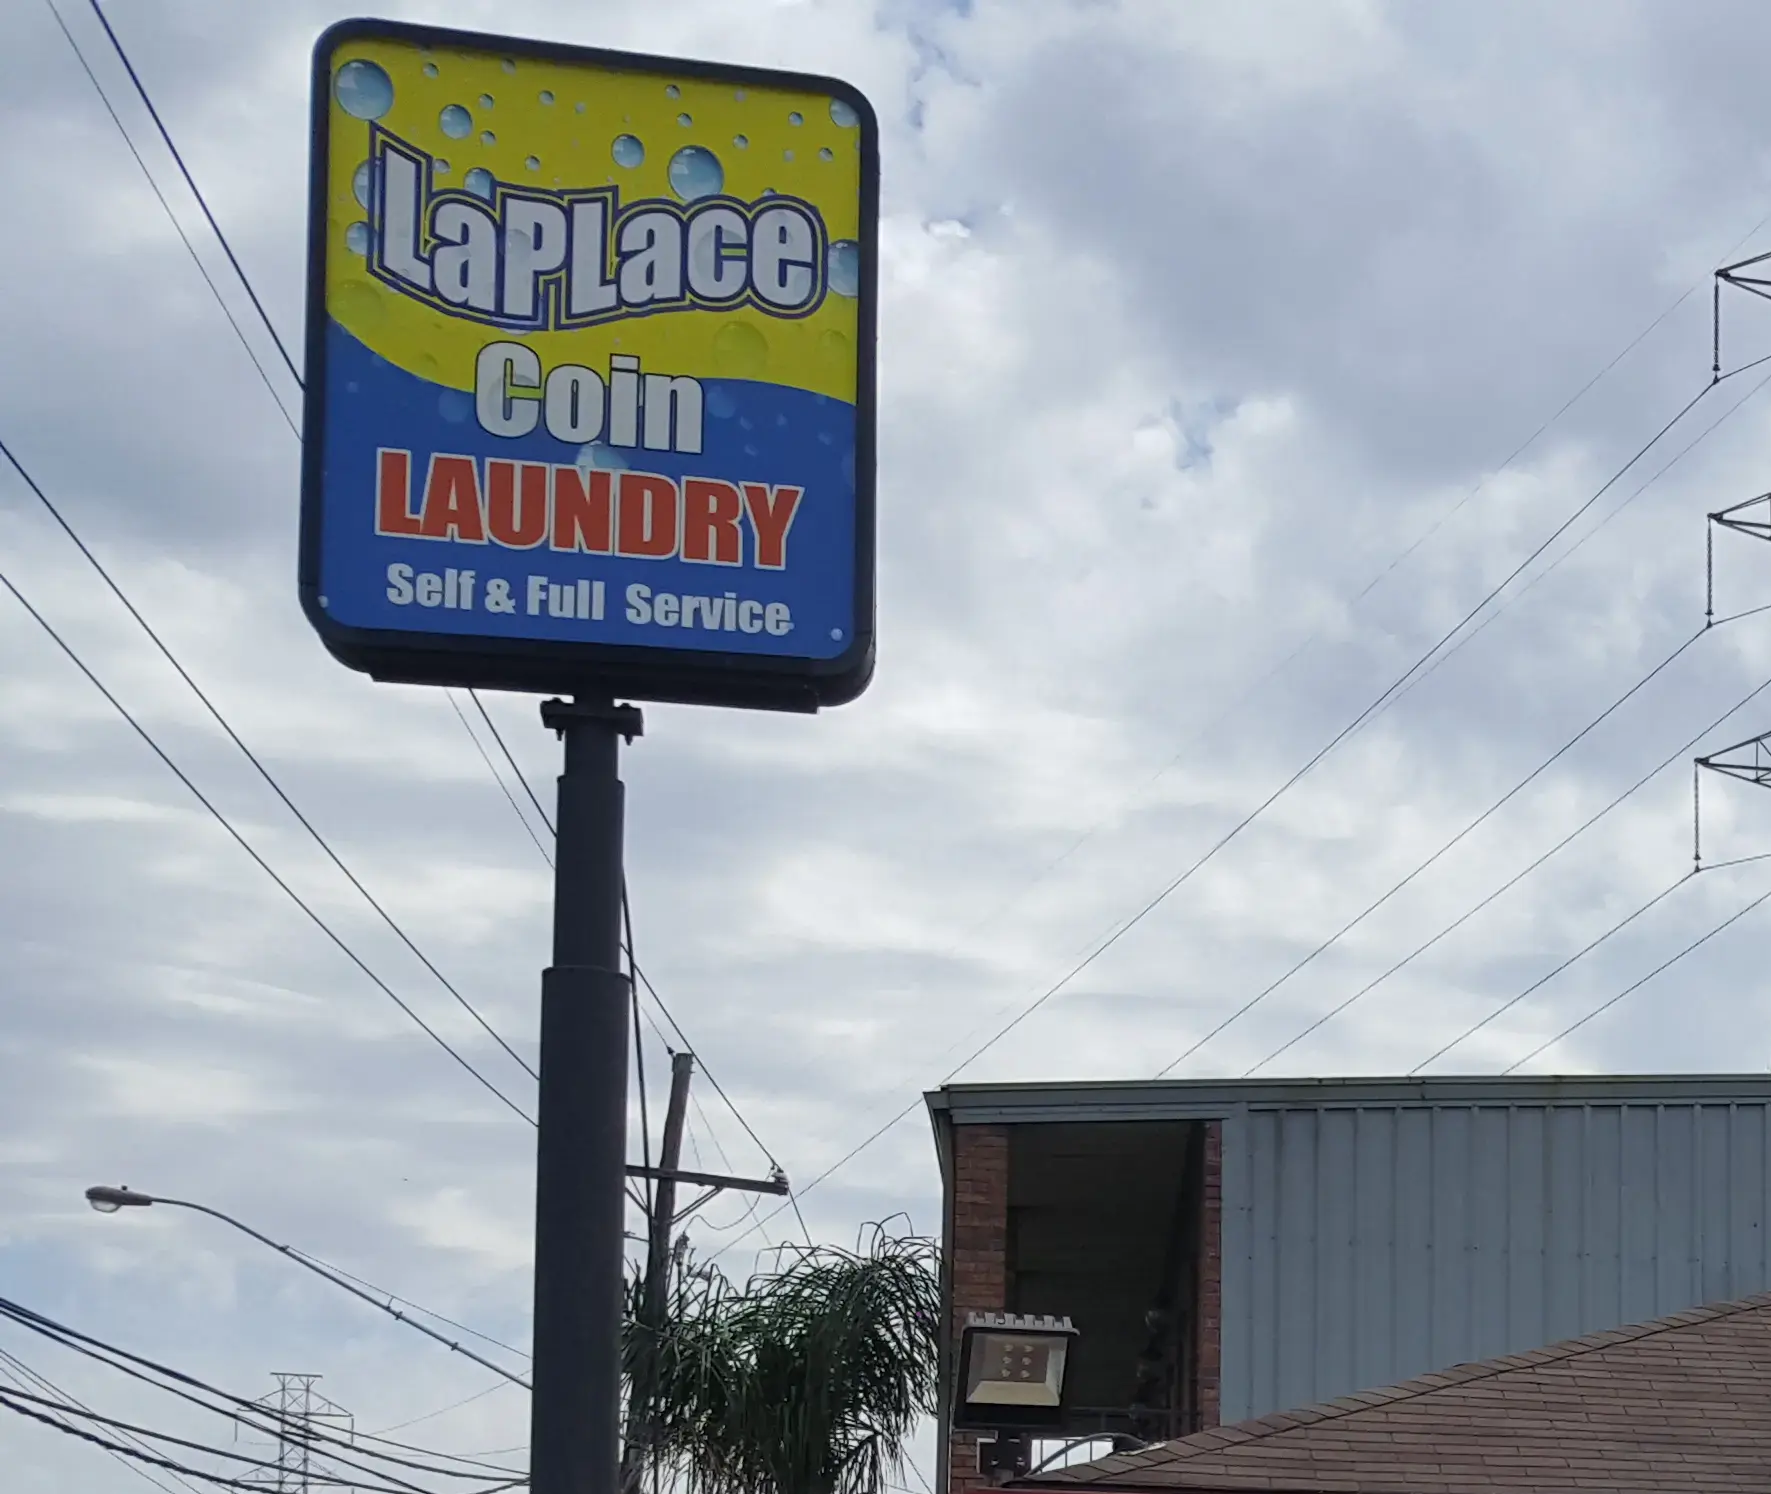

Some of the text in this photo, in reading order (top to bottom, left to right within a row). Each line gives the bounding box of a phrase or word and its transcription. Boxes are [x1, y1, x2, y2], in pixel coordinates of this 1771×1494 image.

[474, 340, 704, 454] Coin
[375, 447, 804, 570] LAUNDRY
[386, 563, 794, 637] Self & Full Service
